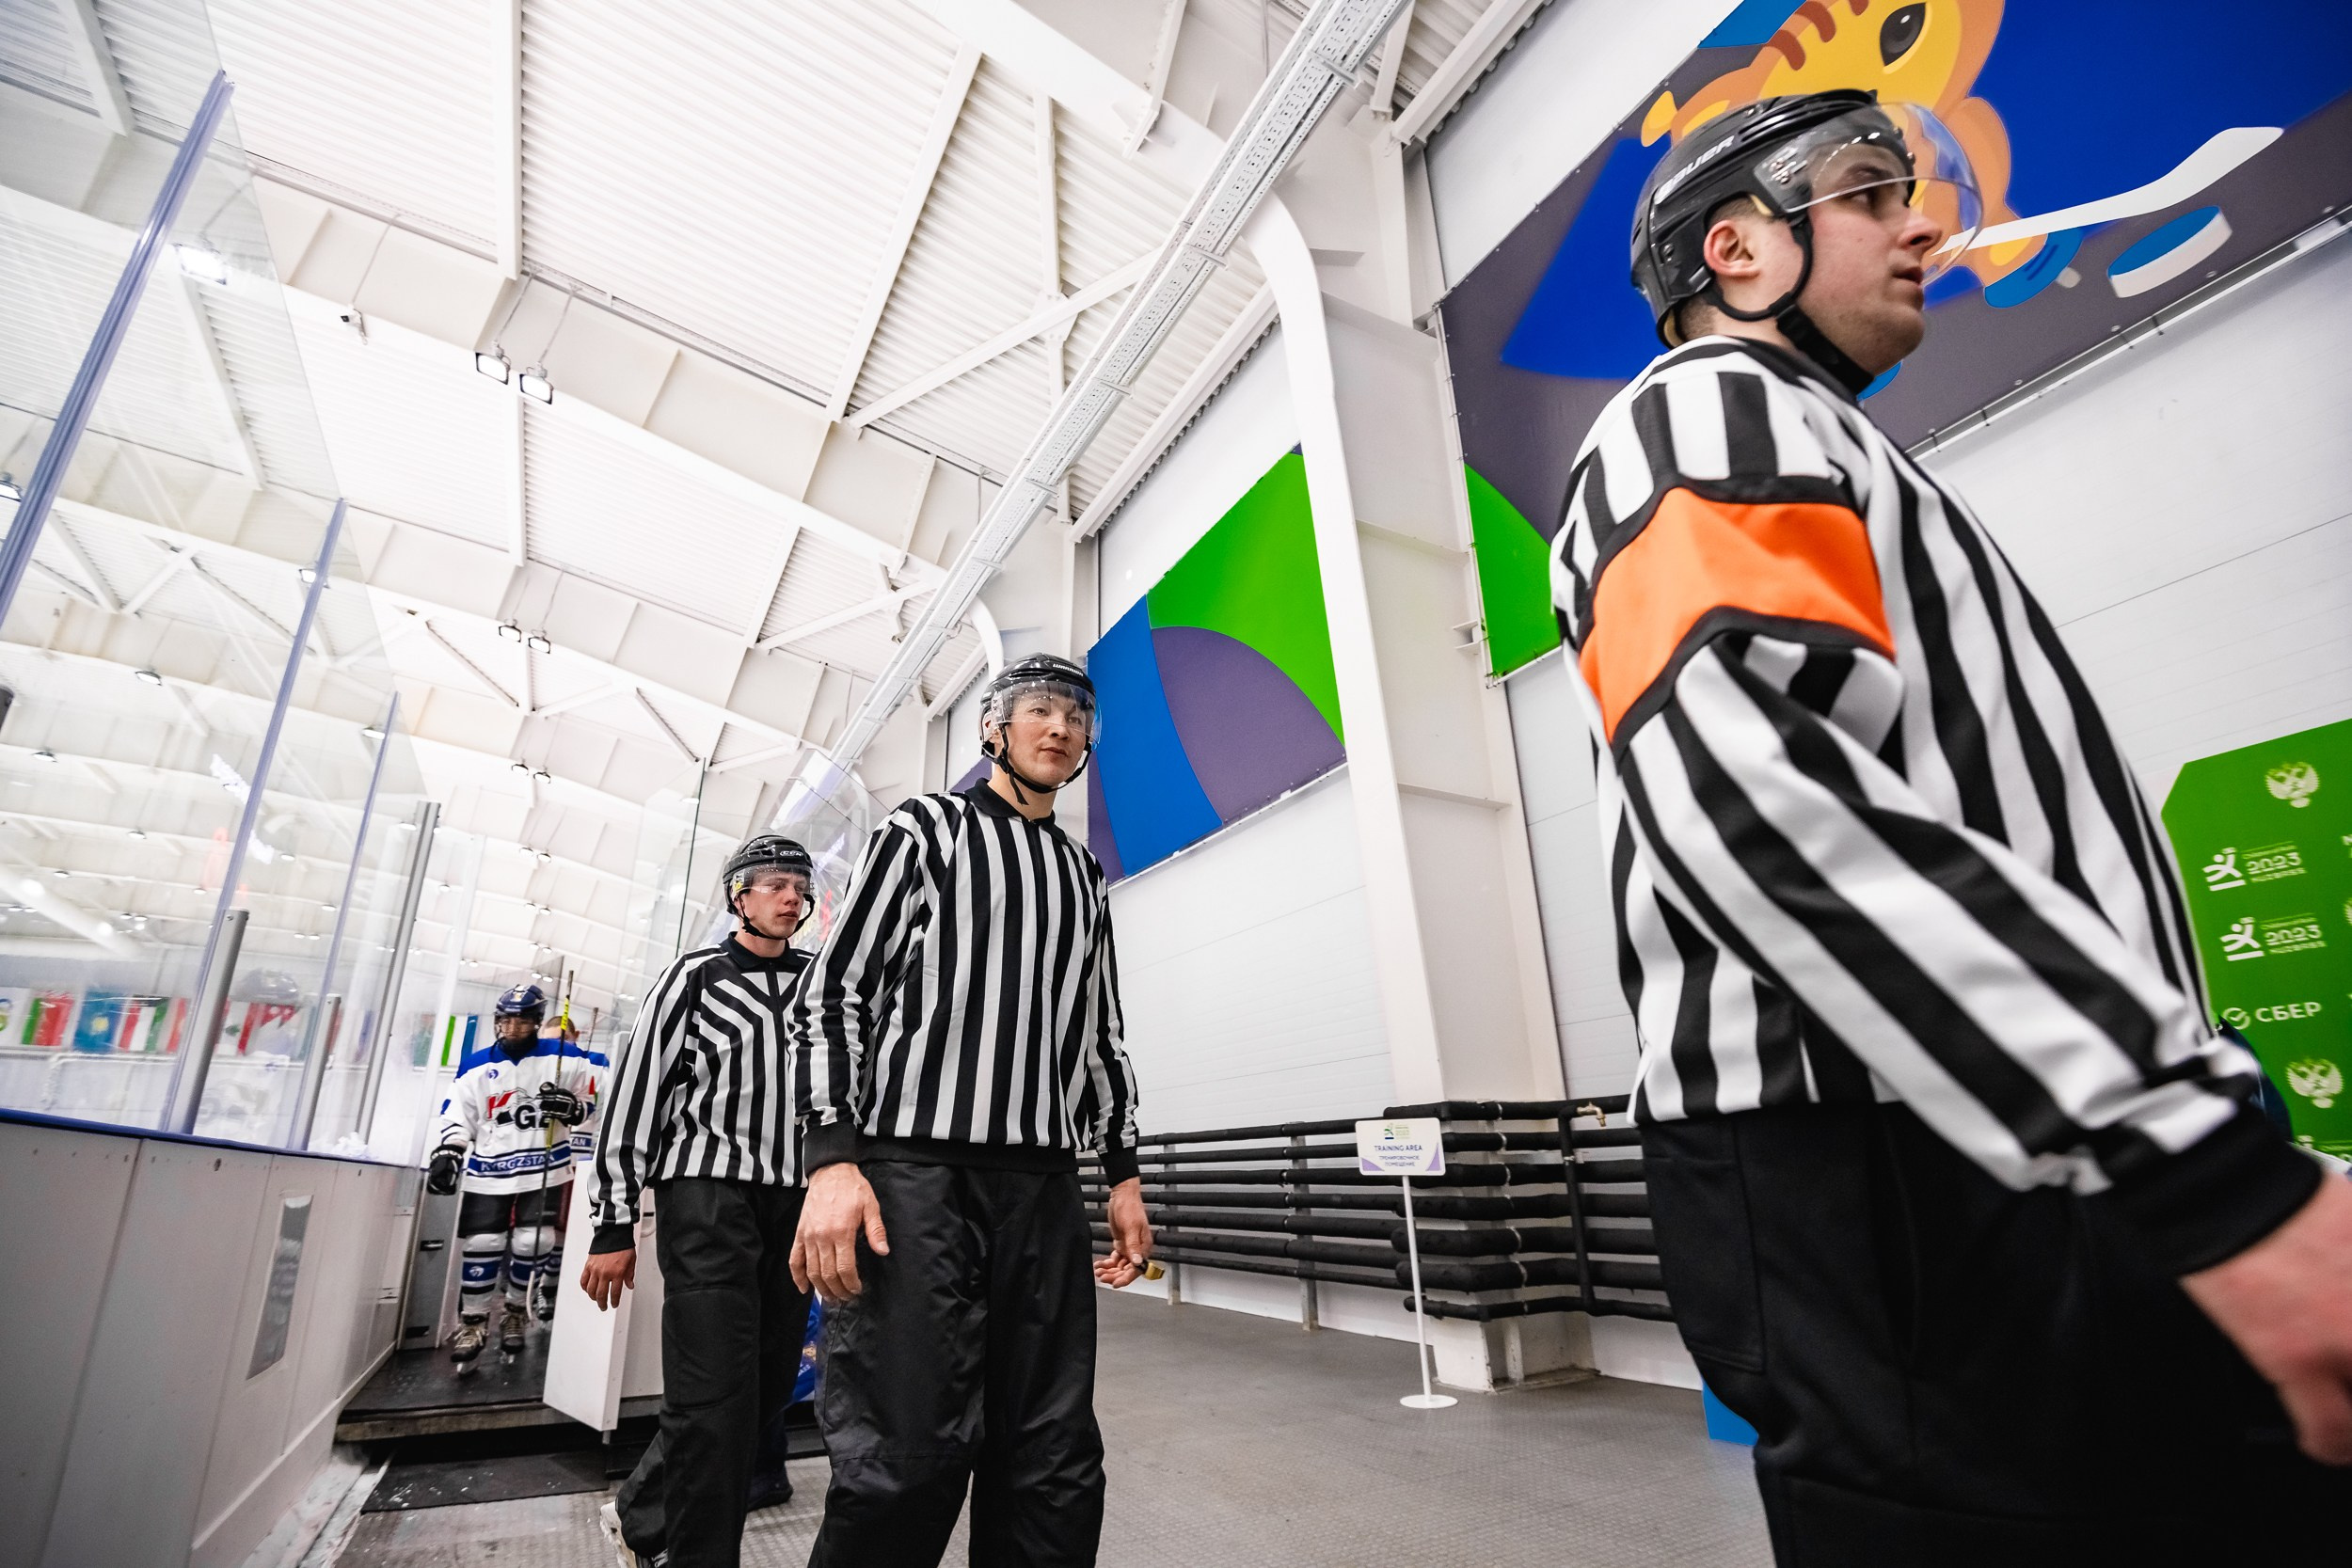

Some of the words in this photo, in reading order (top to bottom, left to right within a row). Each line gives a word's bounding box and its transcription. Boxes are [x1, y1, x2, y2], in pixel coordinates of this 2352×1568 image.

[1654, 135, 1735, 205] BAUER
[2246, 852, 2302, 875] 2023
[2265, 925, 2322, 946] 2023
[2255, 1002, 2322, 1022] СБЕР
